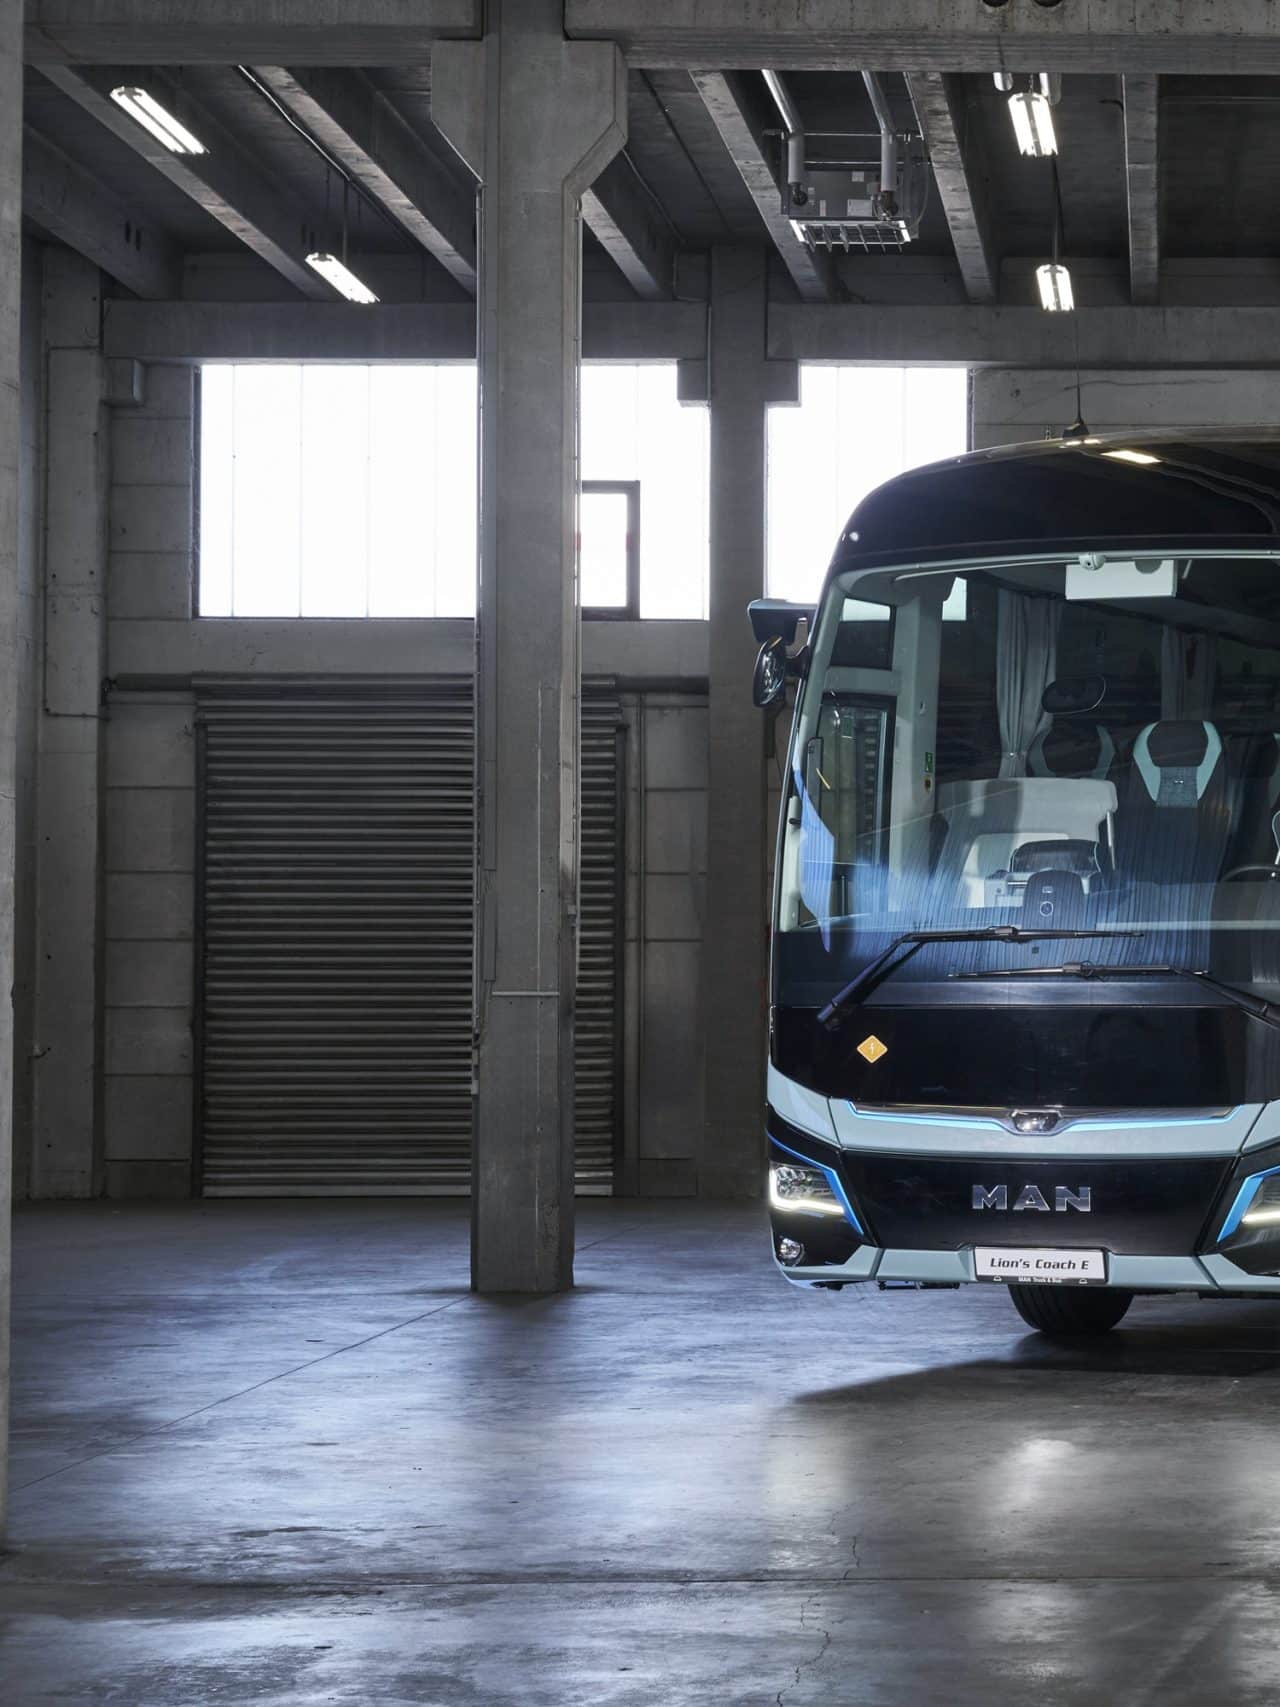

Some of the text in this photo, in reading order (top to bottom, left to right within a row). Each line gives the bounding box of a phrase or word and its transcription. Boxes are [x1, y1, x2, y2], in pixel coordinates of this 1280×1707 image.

[972, 1184, 1091, 1212] MAN
[990, 1257, 1089, 1270] Lion's Coach E
